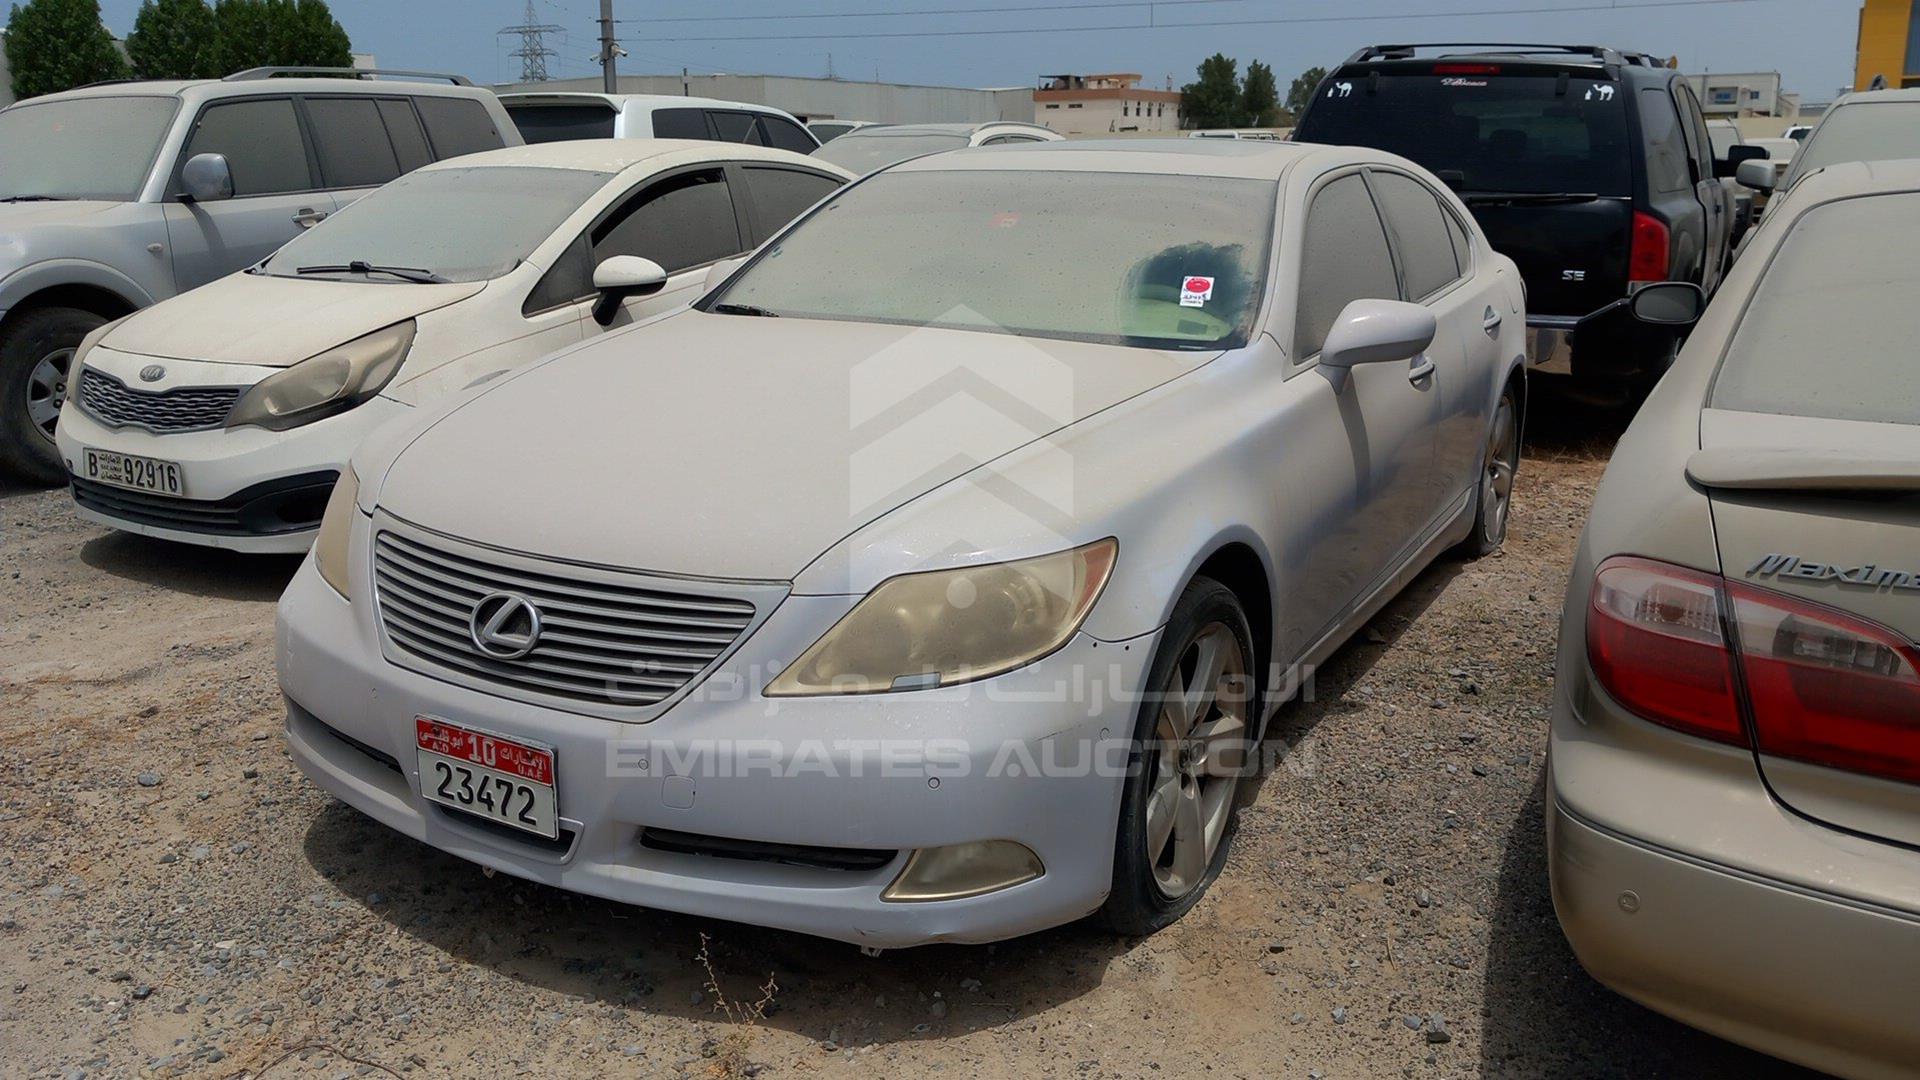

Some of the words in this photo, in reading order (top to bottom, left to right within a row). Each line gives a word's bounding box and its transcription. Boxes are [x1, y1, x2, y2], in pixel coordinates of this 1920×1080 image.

[1562, 269, 1585, 281] SE
[88, 452, 98, 476] B
[124, 458, 178, 492] 92916
[467, 734, 497, 767] 10
[435, 761, 537, 826] 23472
